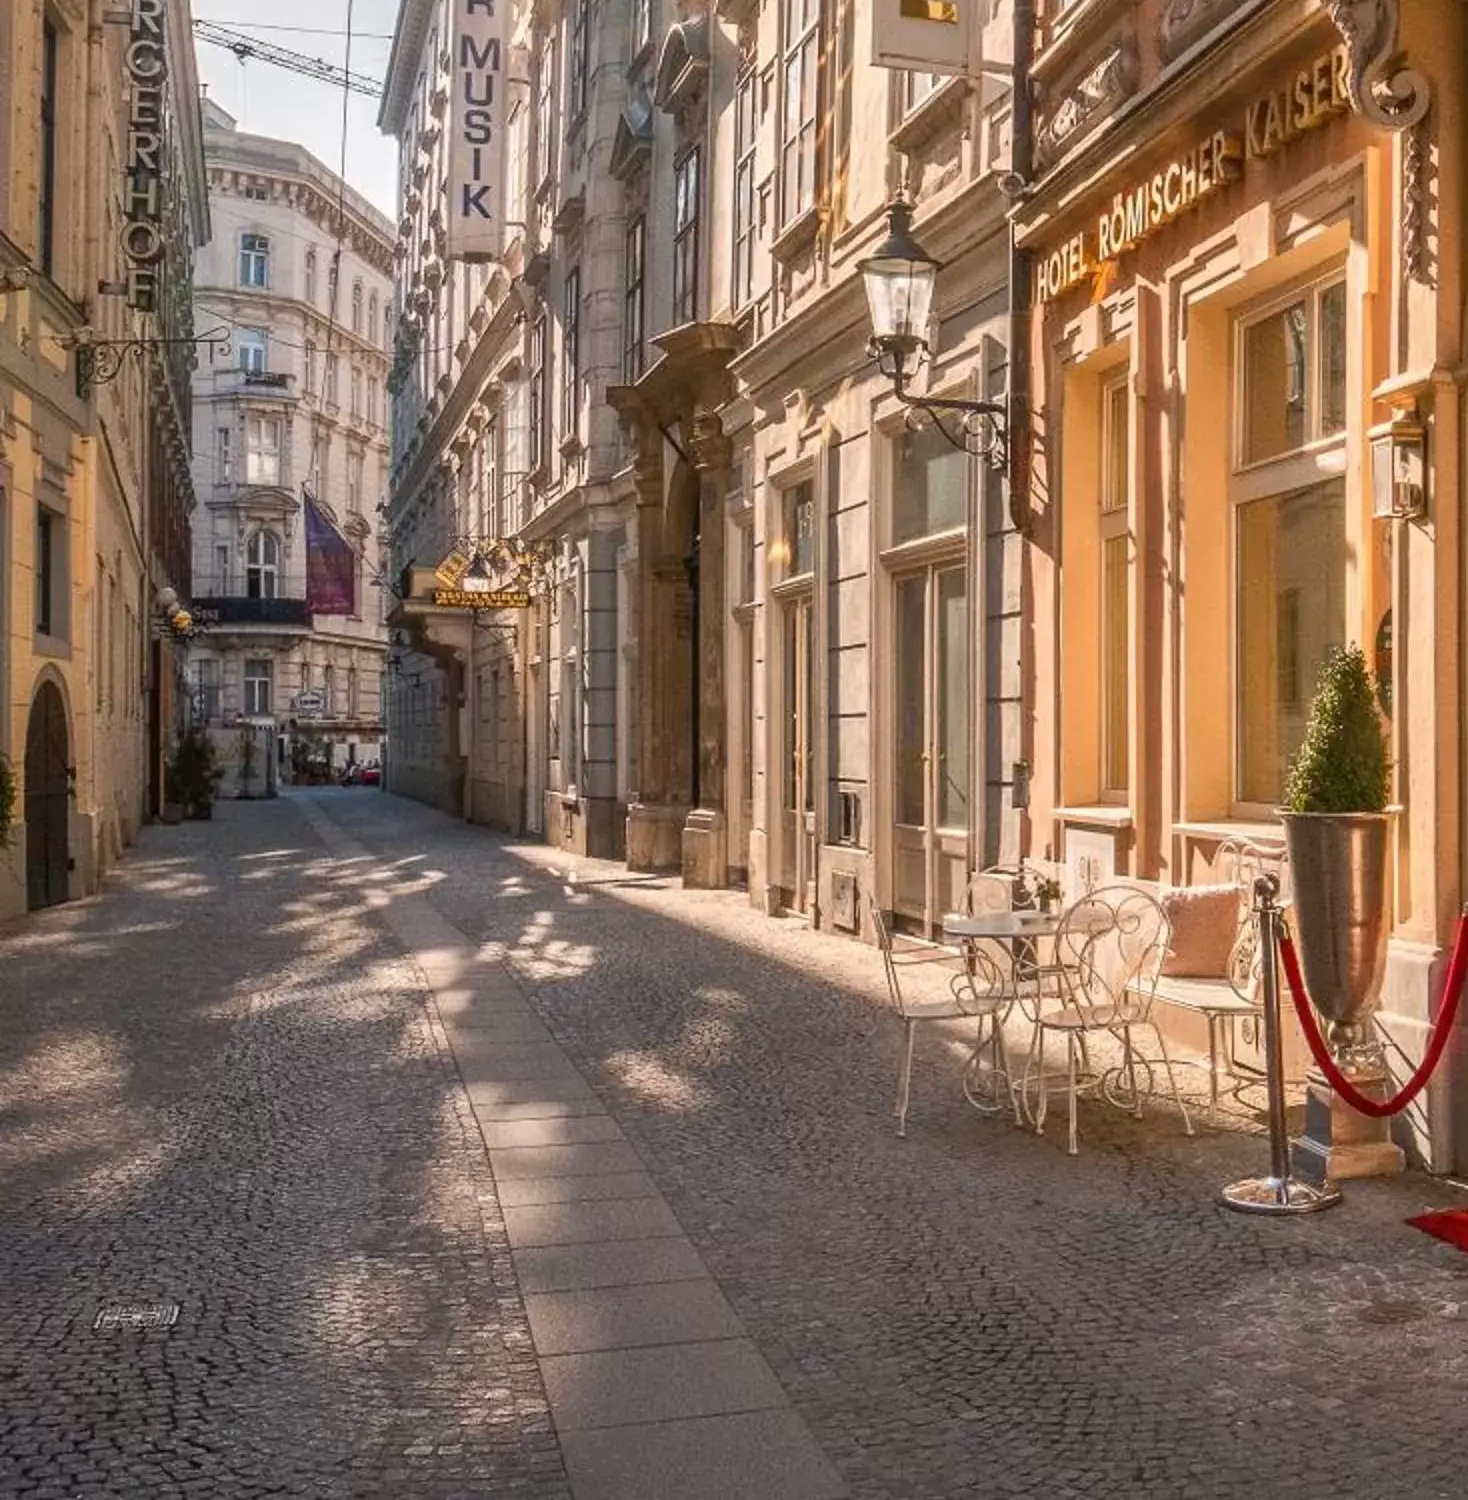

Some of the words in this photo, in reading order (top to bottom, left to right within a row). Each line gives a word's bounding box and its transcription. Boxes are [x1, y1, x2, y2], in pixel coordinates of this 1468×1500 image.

[458, 33, 501, 221] MUSIK
[1036, 231, 1088, 303] HOTEL
[1098, 130, 1226, 260] RÖMISCHER
[1245, 42, 1354, 162] KAISER
